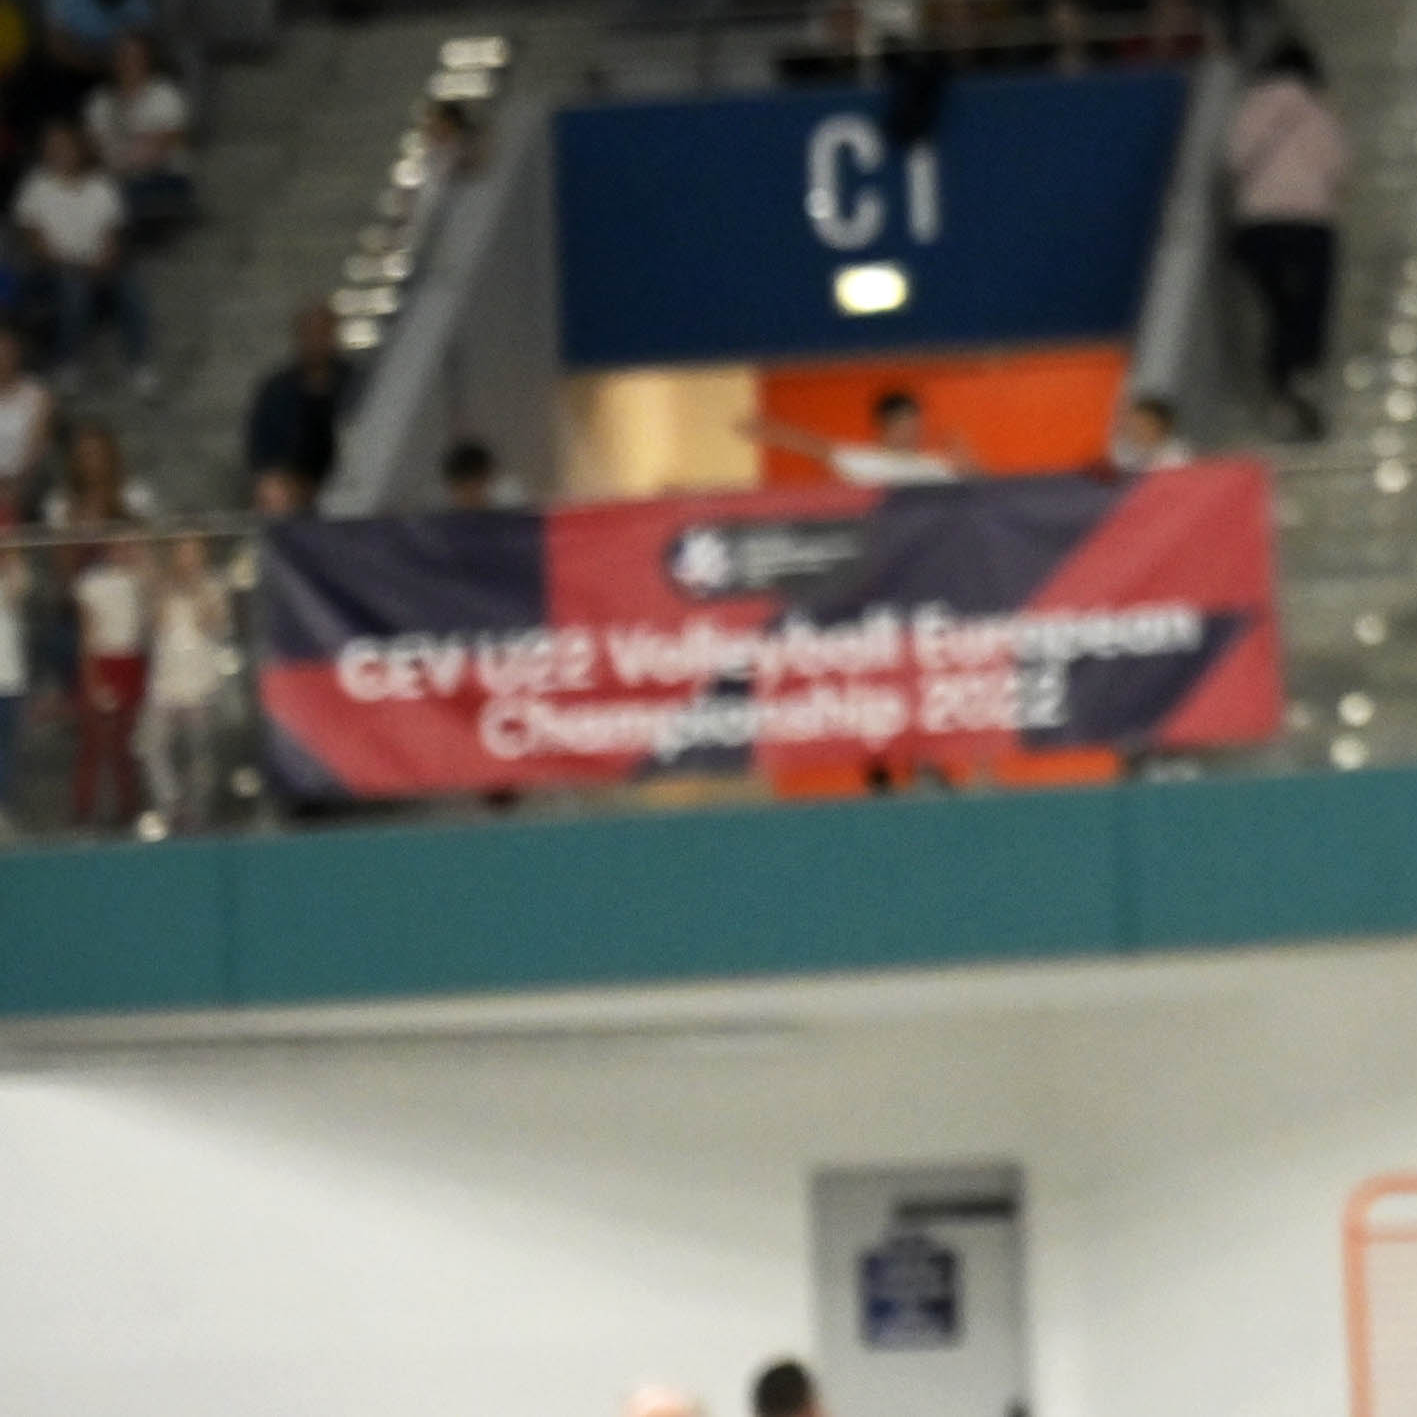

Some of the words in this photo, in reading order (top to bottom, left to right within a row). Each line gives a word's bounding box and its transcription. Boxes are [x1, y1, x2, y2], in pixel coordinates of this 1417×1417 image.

[806, 112, 942, 251] C1
[337, 631, 467, 702] CEV
[474, 622, 595, 692] U22
[605, 602, 900, 699] Volleyball
[910, 598, 1203, 668] European
[478, 681, 906, 762] Championship
[919, 662, 1072, 733] 2022
